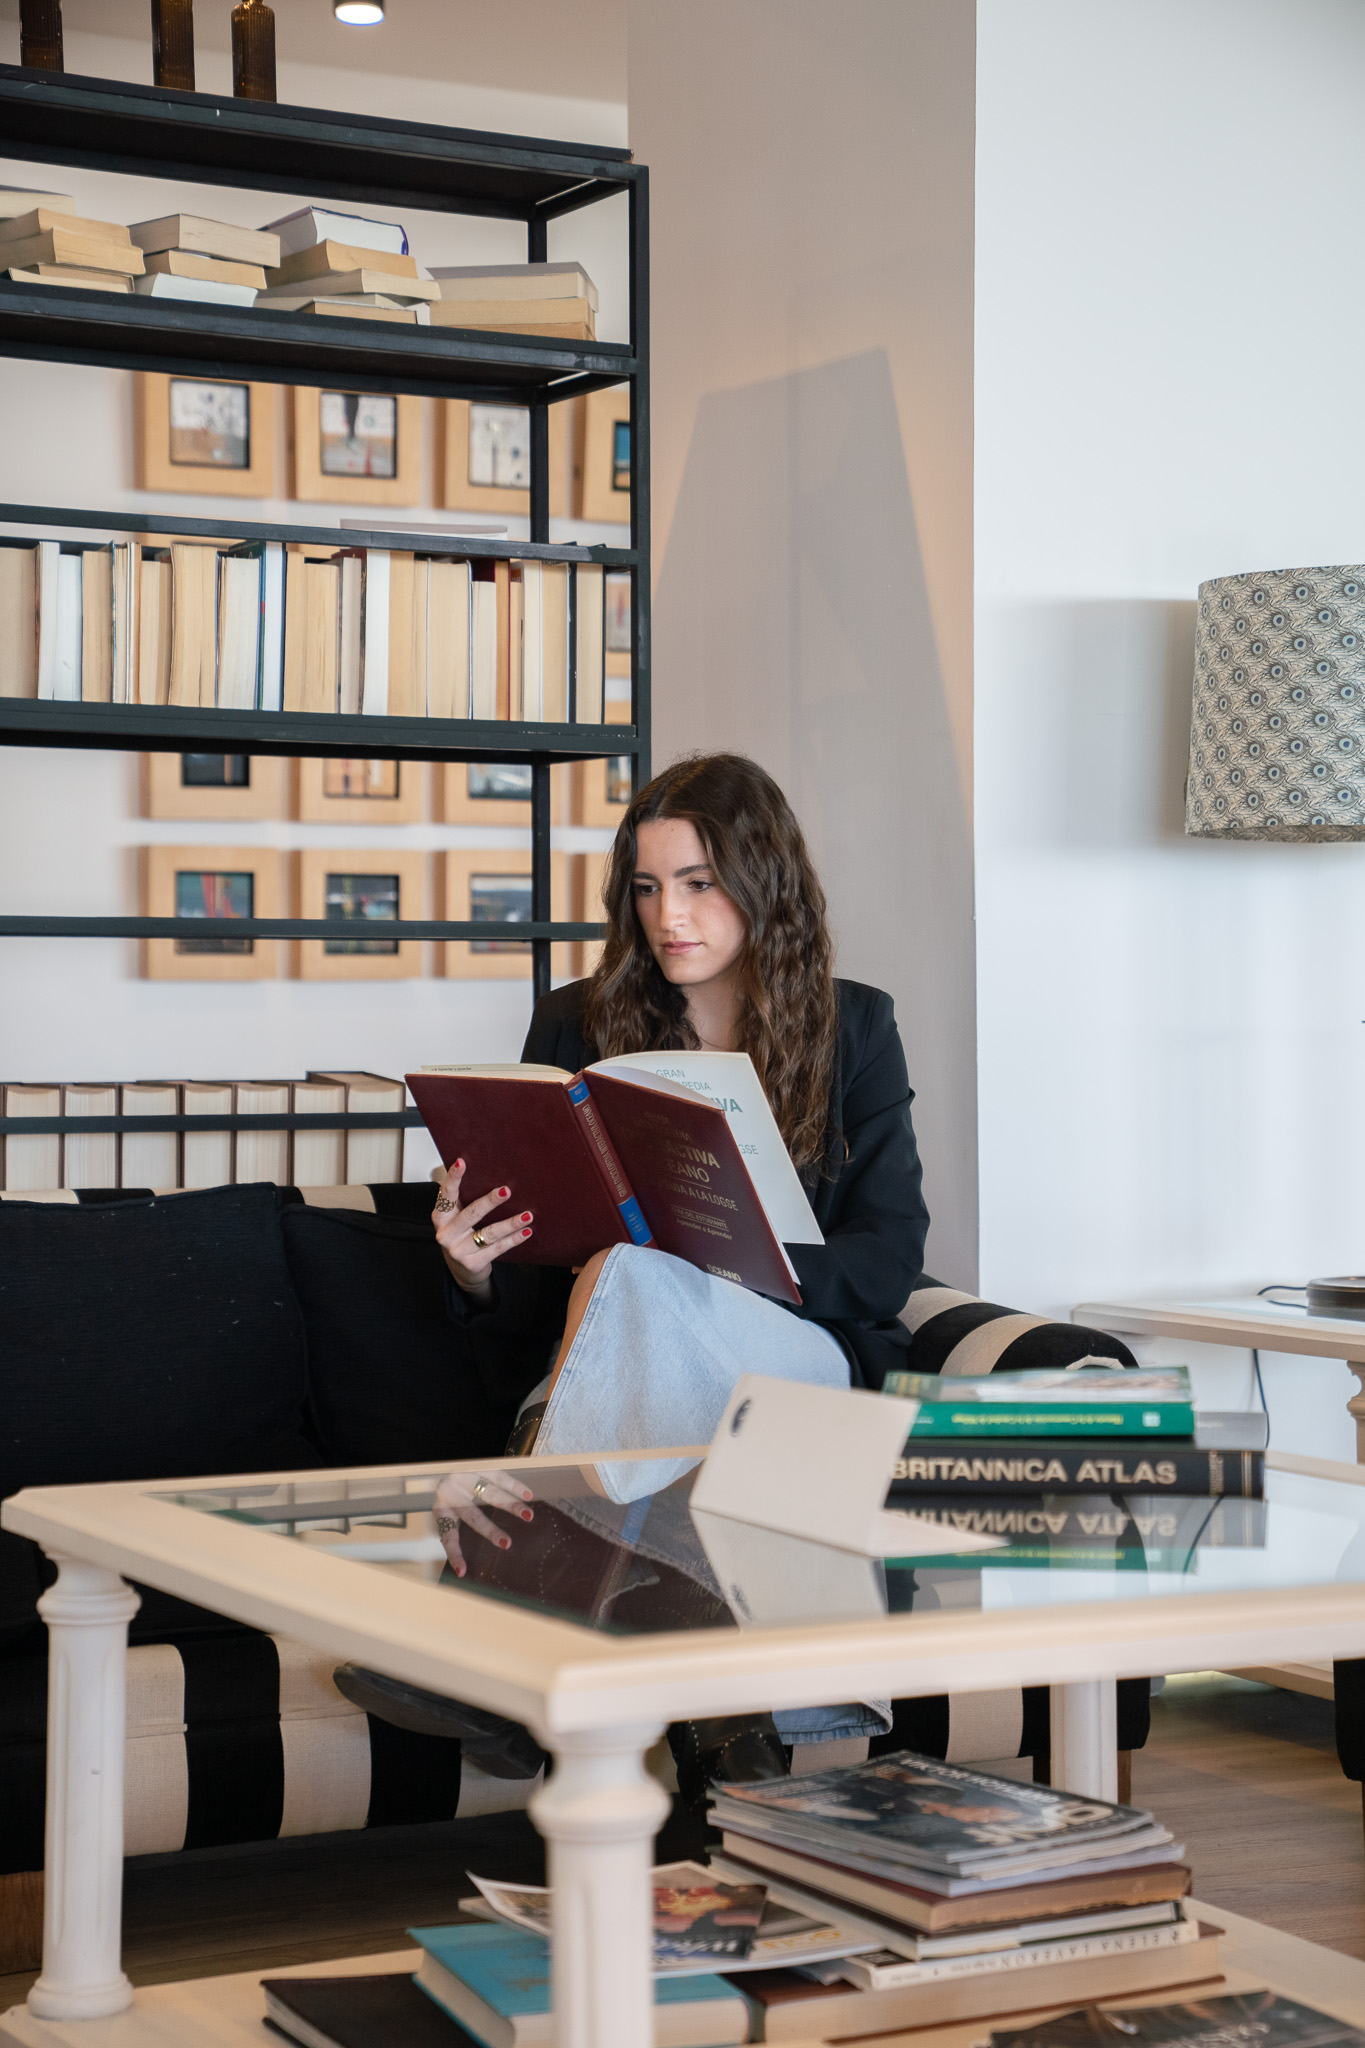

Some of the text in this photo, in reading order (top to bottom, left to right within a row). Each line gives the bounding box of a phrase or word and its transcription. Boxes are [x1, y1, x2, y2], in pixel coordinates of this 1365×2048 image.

[656, 1069, 686, 1078] GRAN
[709, 1194, 739, 1211] LOGSE
[706, 1263, 742, 1282] OCEANO
[889, 1457, 1069, 1482] BRITANNICA
[1075, 1459, 1178, 1485] ATLAS
